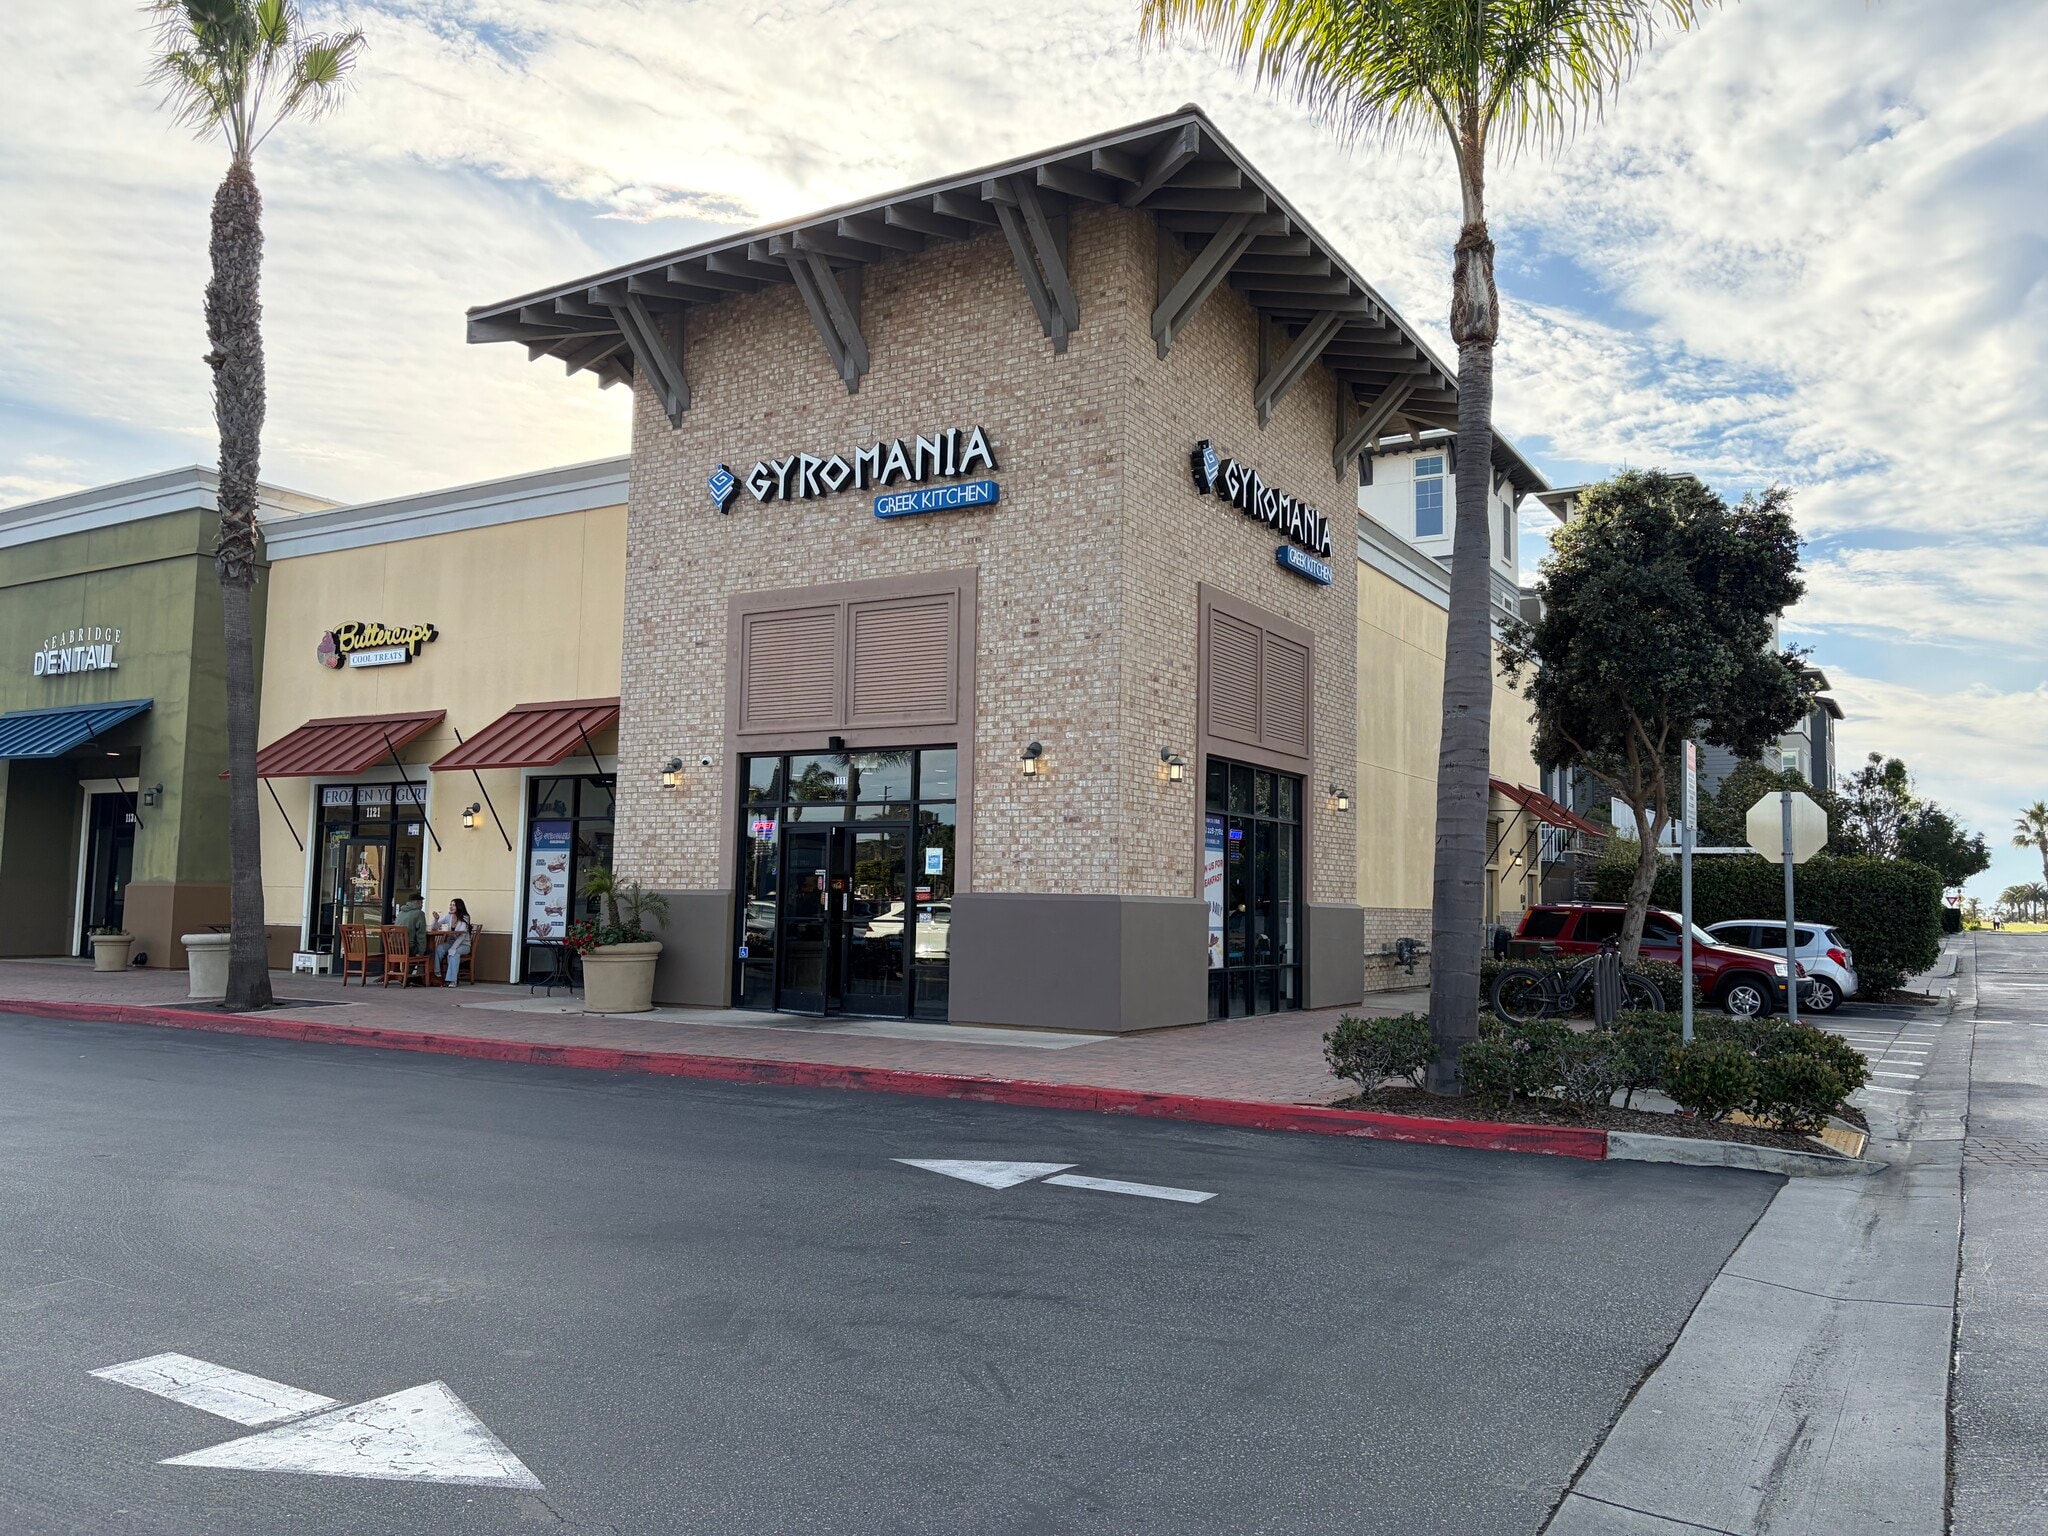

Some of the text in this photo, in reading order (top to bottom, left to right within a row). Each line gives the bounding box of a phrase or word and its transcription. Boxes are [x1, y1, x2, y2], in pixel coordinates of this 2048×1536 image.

[746, 425, 996, 501] GYROMANIA
[877, 483, 989, 514] GREEK KITCHEN
[1222, 458, 1333, 557] GYROMANIA
[43, 627, 121, 653] SEABRIDGE
[333, 620, 436, 656] Buttercups
[34, 644, 117, 676] DENTAL
[352, 651, 403, 664] COOL TREATS
[366, 807, 380, 817] 1121
